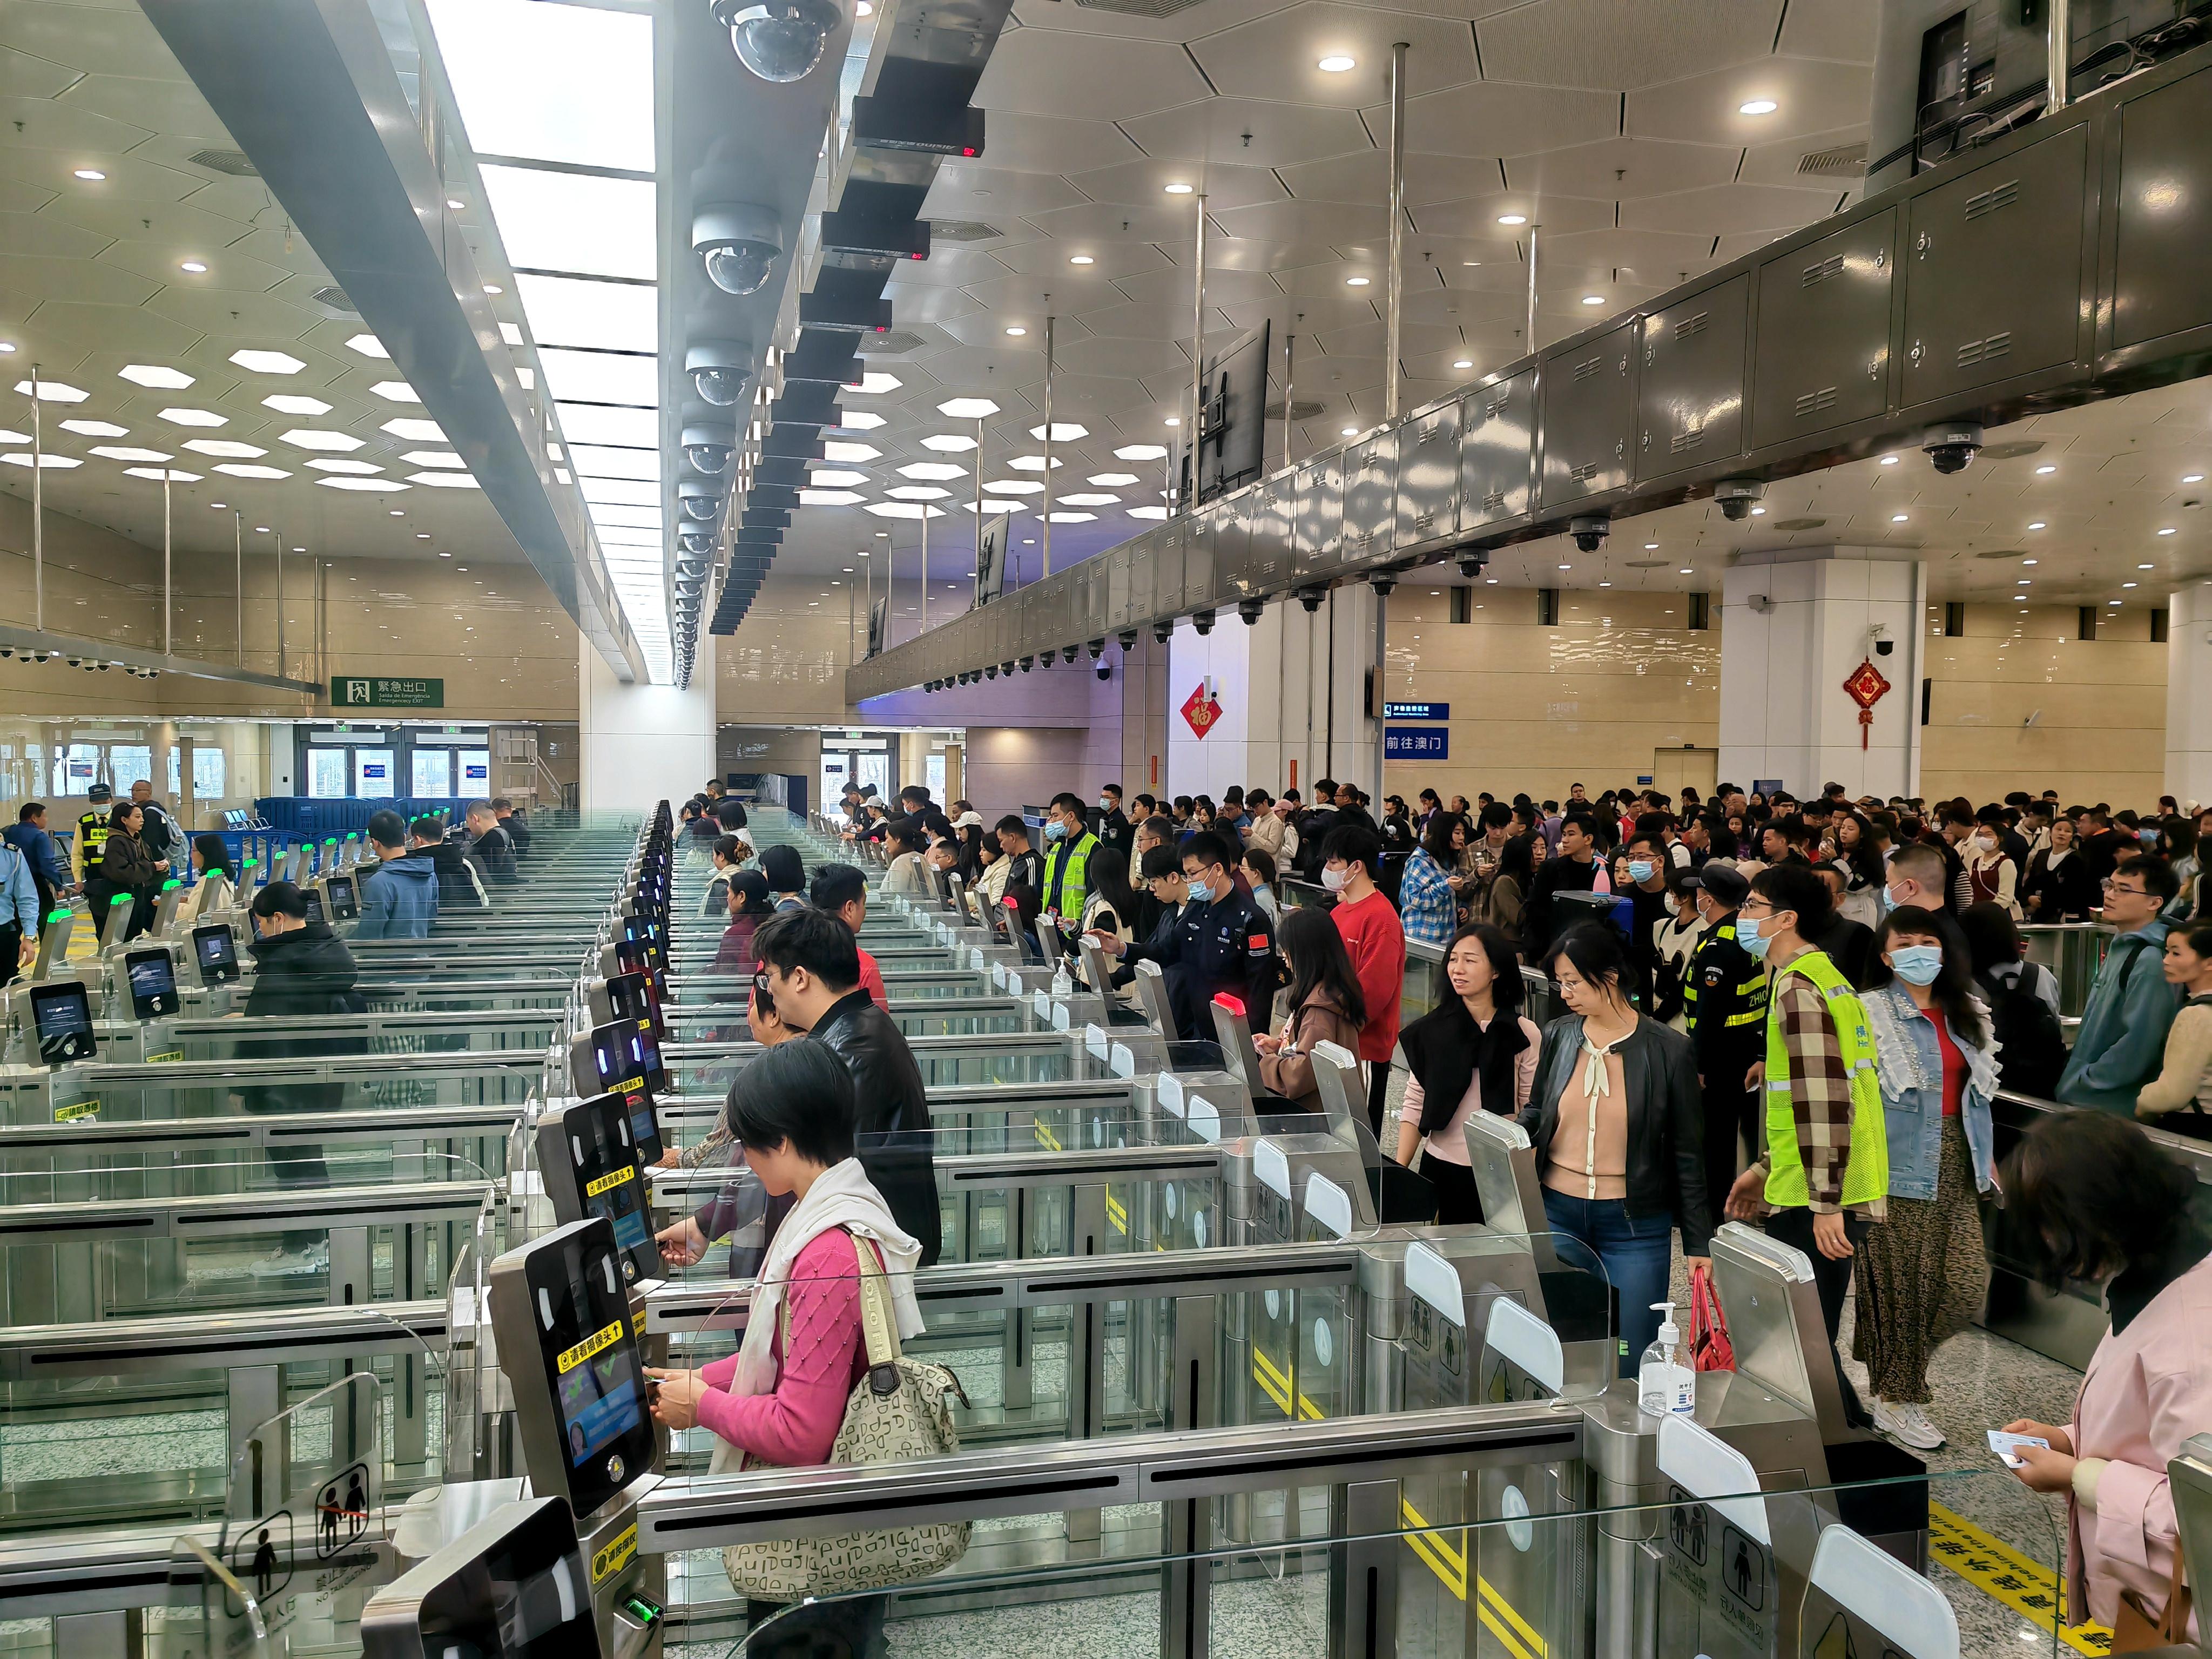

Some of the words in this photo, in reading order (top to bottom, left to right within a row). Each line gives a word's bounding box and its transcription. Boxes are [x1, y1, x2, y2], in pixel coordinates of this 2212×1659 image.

[378, 680, 426, 692] 緊急出口
[1190, 697, 1212, 726] 福
[1386, 736, 1441, 750] 前往澳门
[595, 1170, 626, 1191] 请看摄像头
[570, 1328, 612, 1364] 请看摄像头
[1929, 1513, 1964, 1532] yello
[609, 1531, 636, 1563] 请按指纹
[1961, 1534, 1986, 1549] the
[1984, 1549, 2039, 1580] behind
